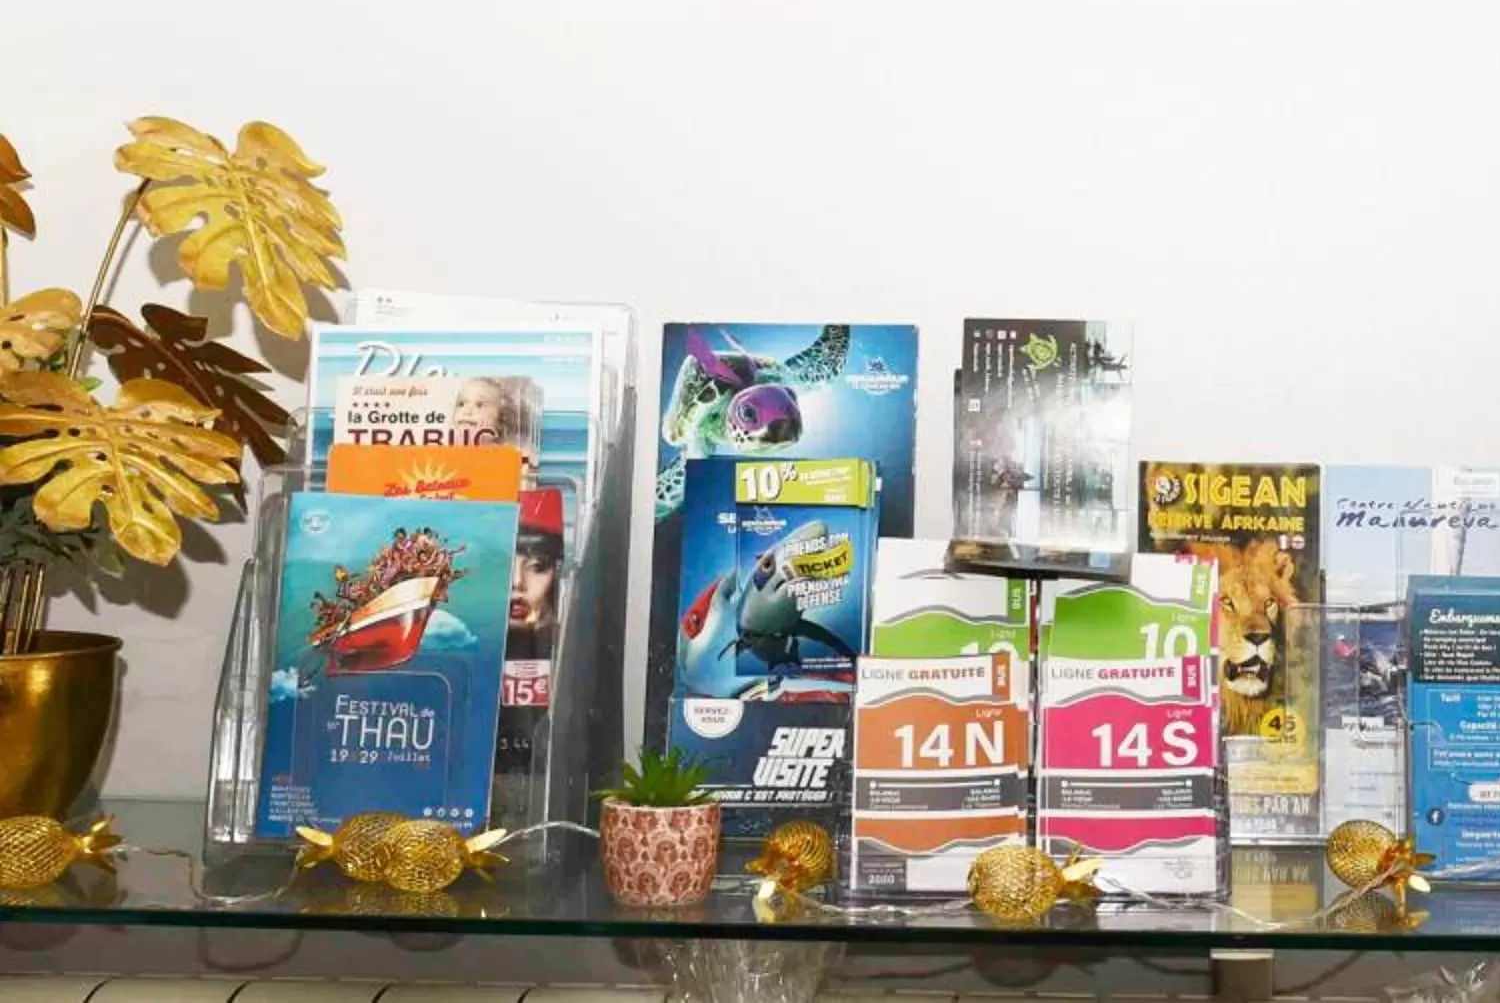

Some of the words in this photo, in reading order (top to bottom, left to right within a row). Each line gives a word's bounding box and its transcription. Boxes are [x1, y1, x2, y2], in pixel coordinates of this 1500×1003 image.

[348, 410, 362, 424] la
[367, 410, 420, 424] Grotte
[425, 410, 446, 424] de
[1184, 474, 1307, 508] SIGEAN
[1336, 510, 1500, 528] Manureva
[799, 552, 848, 573] TICKET
[861, 669, 906, 680] LIGNE
[908, 666, 986, 680] GRATUITE
[1051, 668, 1093, 680] LIGNE
[1097, 666, 1176, 680] GRATUITE
[336, 694, 420, 718] FESTIVAL
[335, 714, 435, 750] THAU
[767, 726, 846, 758] SUPER
[330, 748, 349, 763] 19
[358, 750, 379, 765] 29
